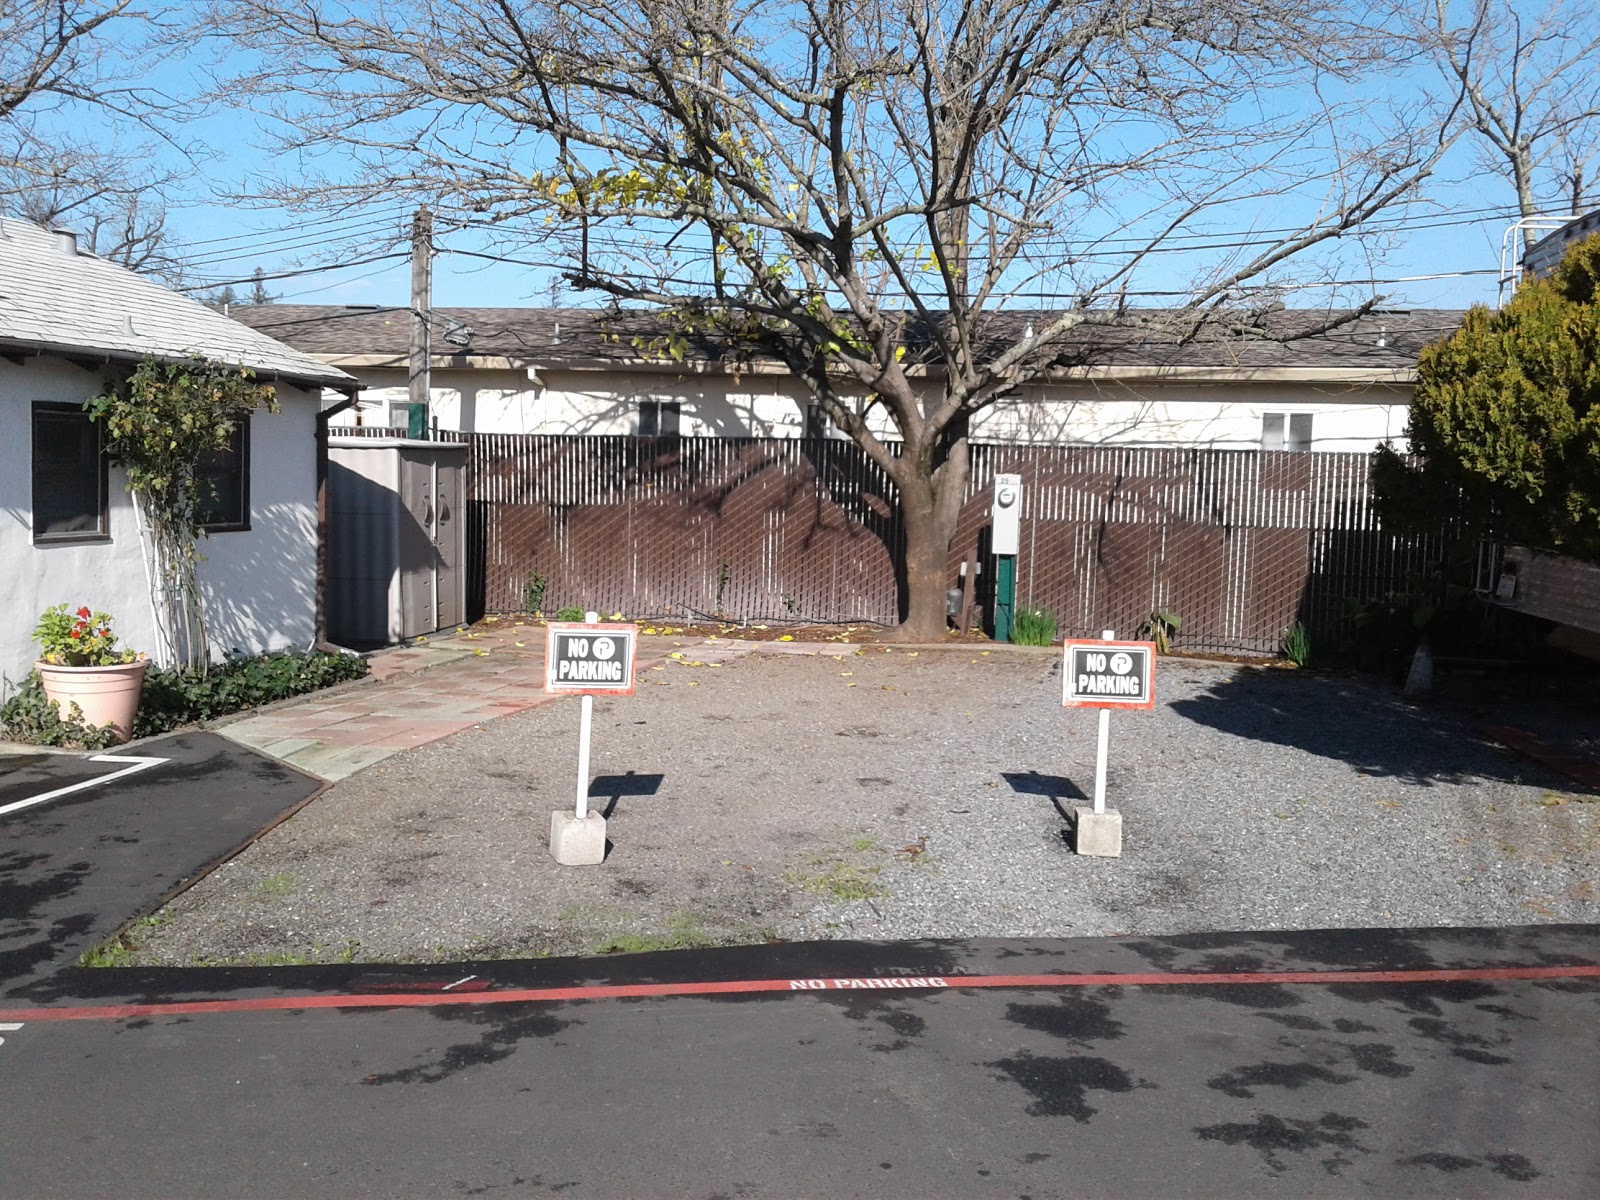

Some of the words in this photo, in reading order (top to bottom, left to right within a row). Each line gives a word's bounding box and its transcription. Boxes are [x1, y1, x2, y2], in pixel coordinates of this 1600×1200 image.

[1000, 477, 1009, 485] 25
[567, 637, 589, 658] NO
[559, 660, 622, 680] PARKING
[1086, 653, 1107, 672] NO
[1078, 674, 1140, 695] PARKING
[789, 979, 826, 990] NO
[834, 977, 948, 989] PARKING
